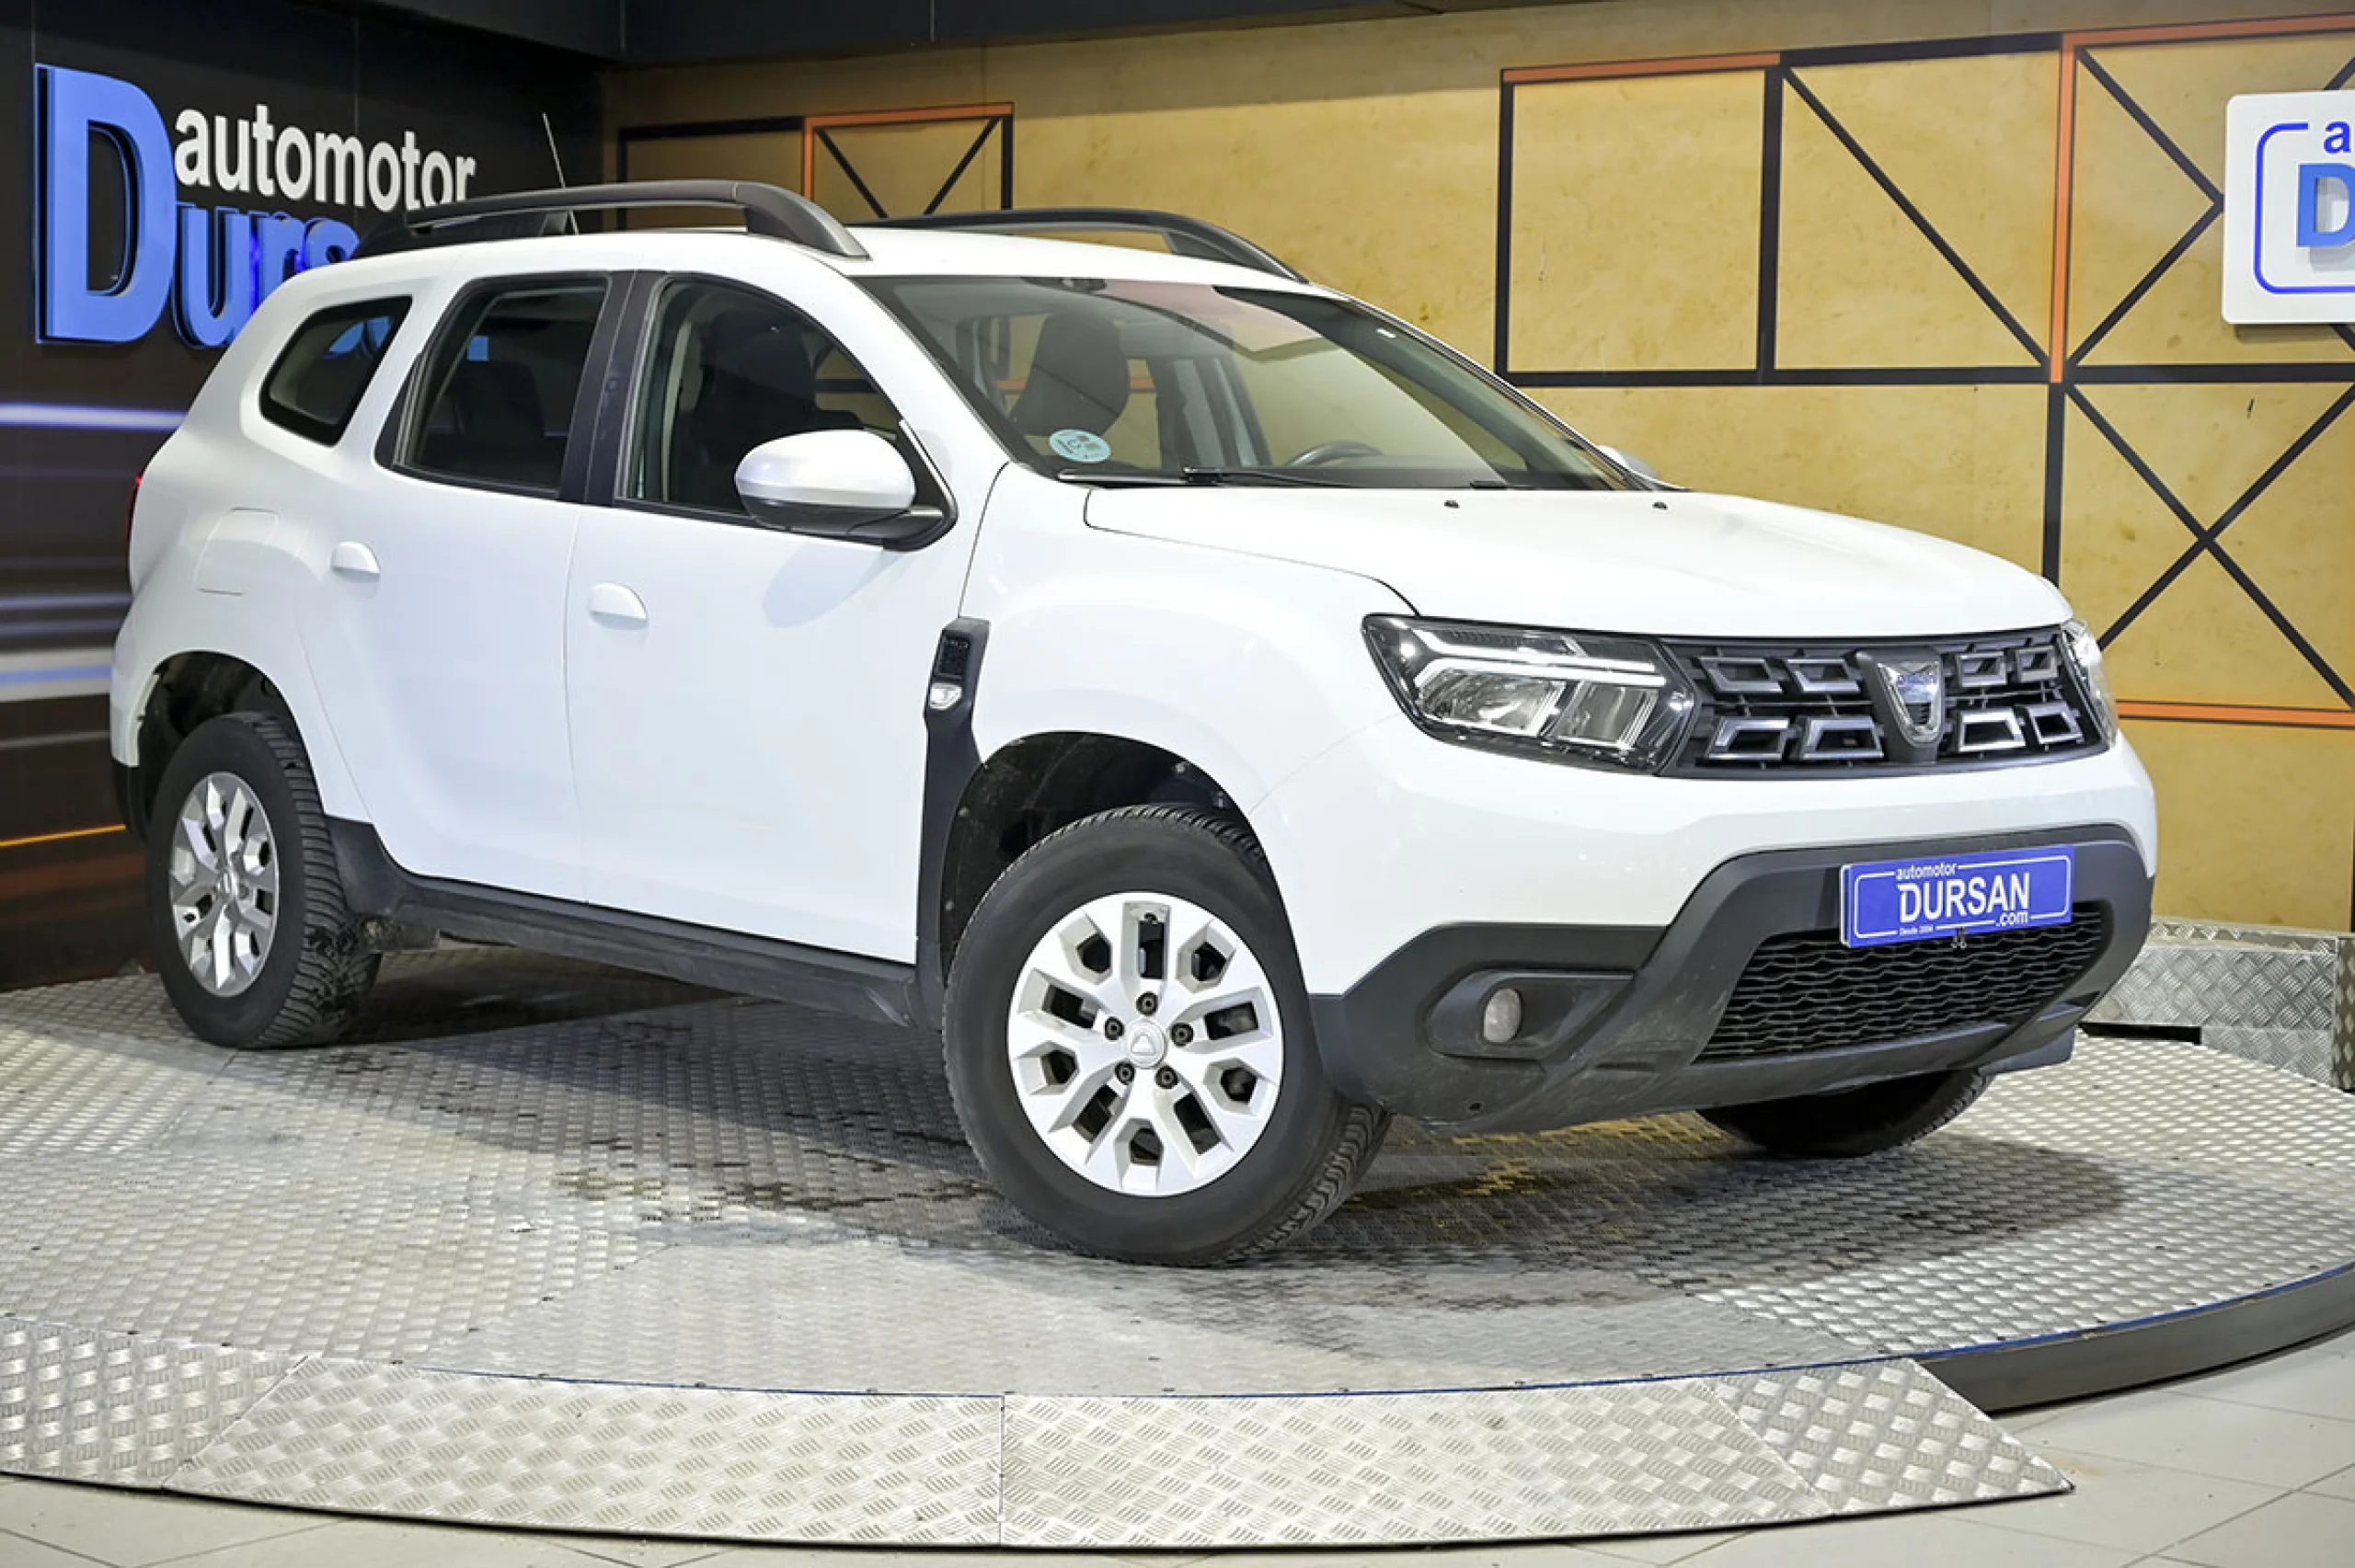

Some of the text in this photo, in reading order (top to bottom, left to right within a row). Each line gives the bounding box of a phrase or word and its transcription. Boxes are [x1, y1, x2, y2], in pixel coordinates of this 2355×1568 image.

[173, 103, 477, 212] automotor
[1895, 863, 1958, 880] automotor
[1897, 872, 2030, 923] DURSAN
[1994, 911, 2029, 927] .com
